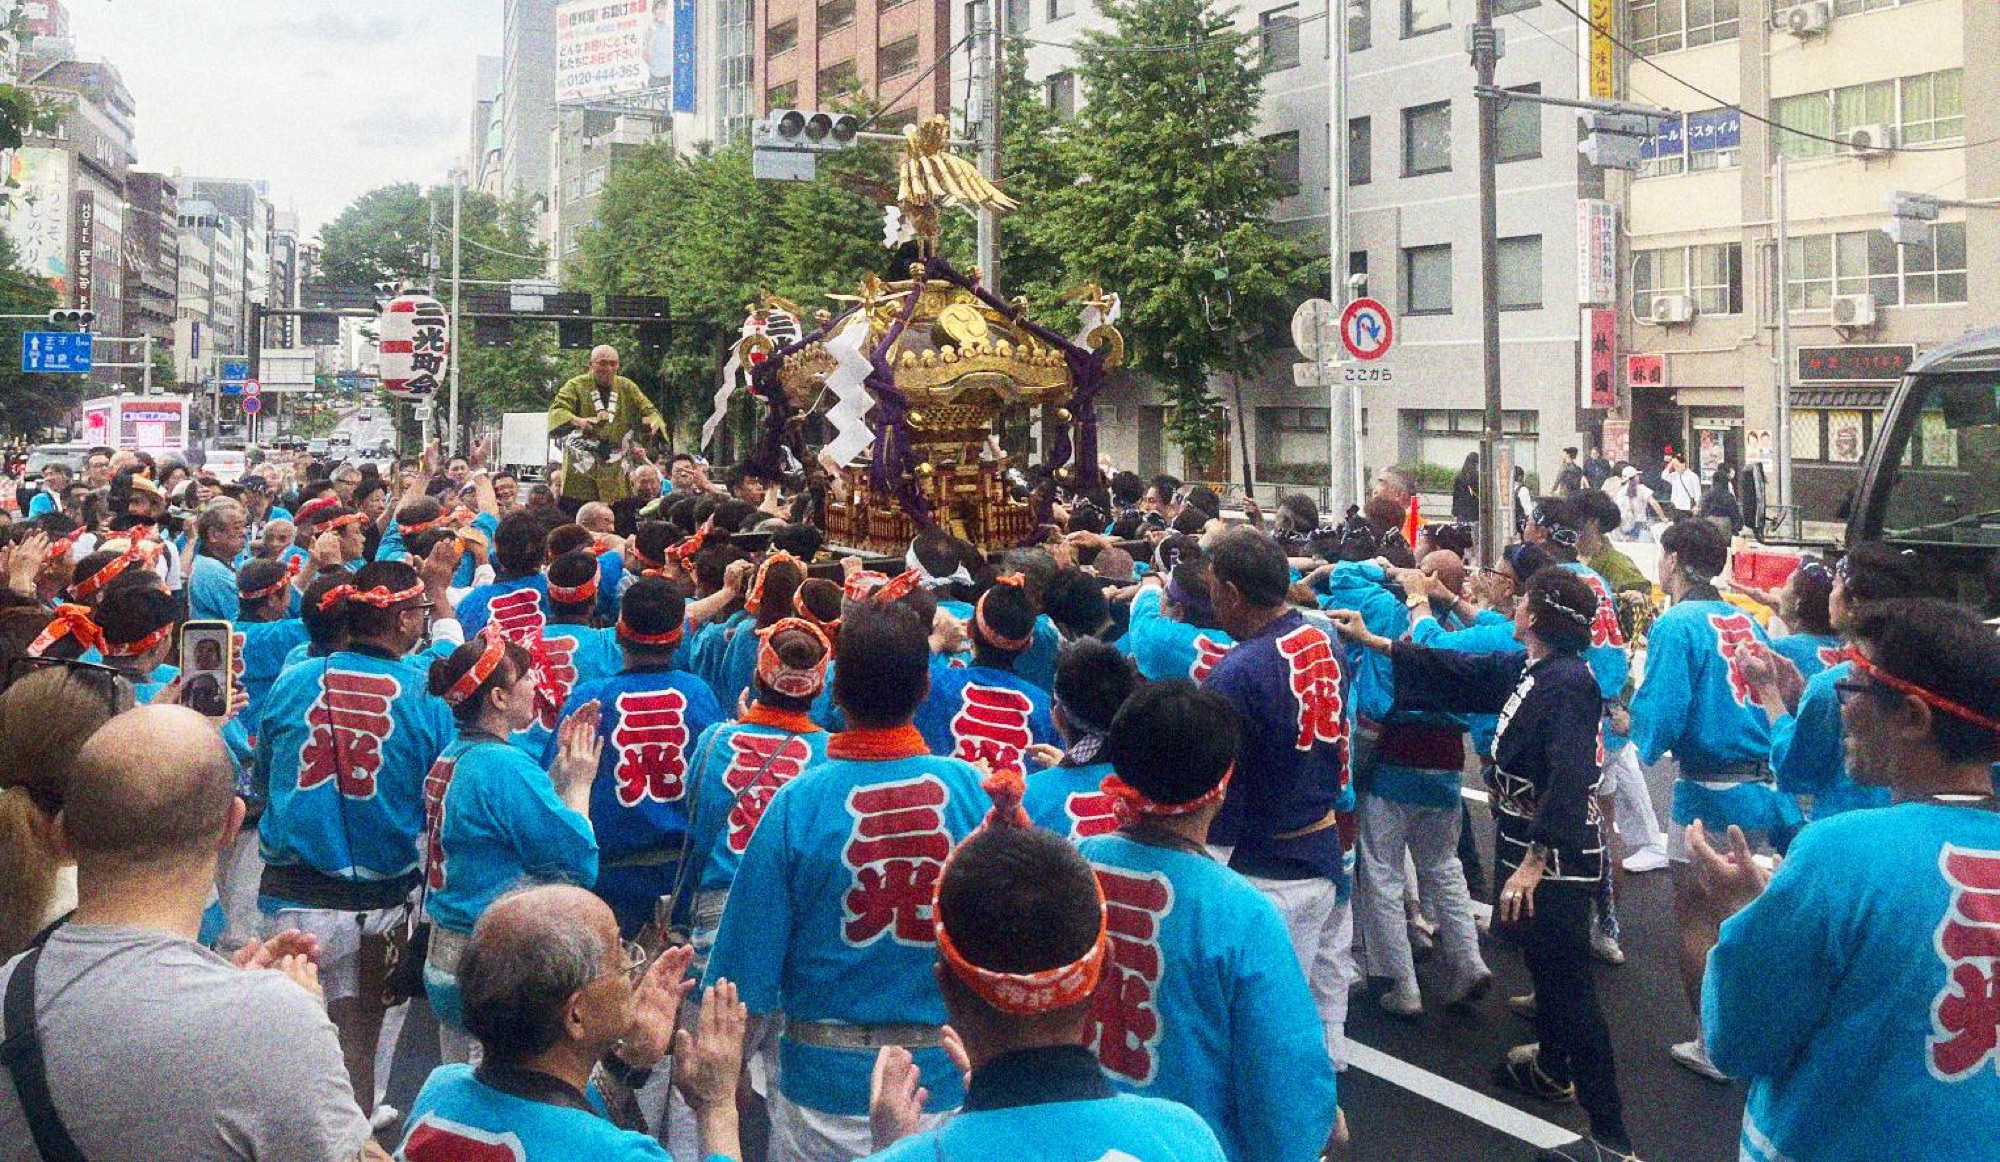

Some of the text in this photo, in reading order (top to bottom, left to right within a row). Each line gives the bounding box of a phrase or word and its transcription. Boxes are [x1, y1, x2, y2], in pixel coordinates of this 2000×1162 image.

[82, 203, 91, 243] HOTEL
[405, 302, 446, 395] 三光町会
[1345, 369, 1392, 381] ここから
[300, 670, 402, 799] 三光
[613, 688, 688, 807] 三光
